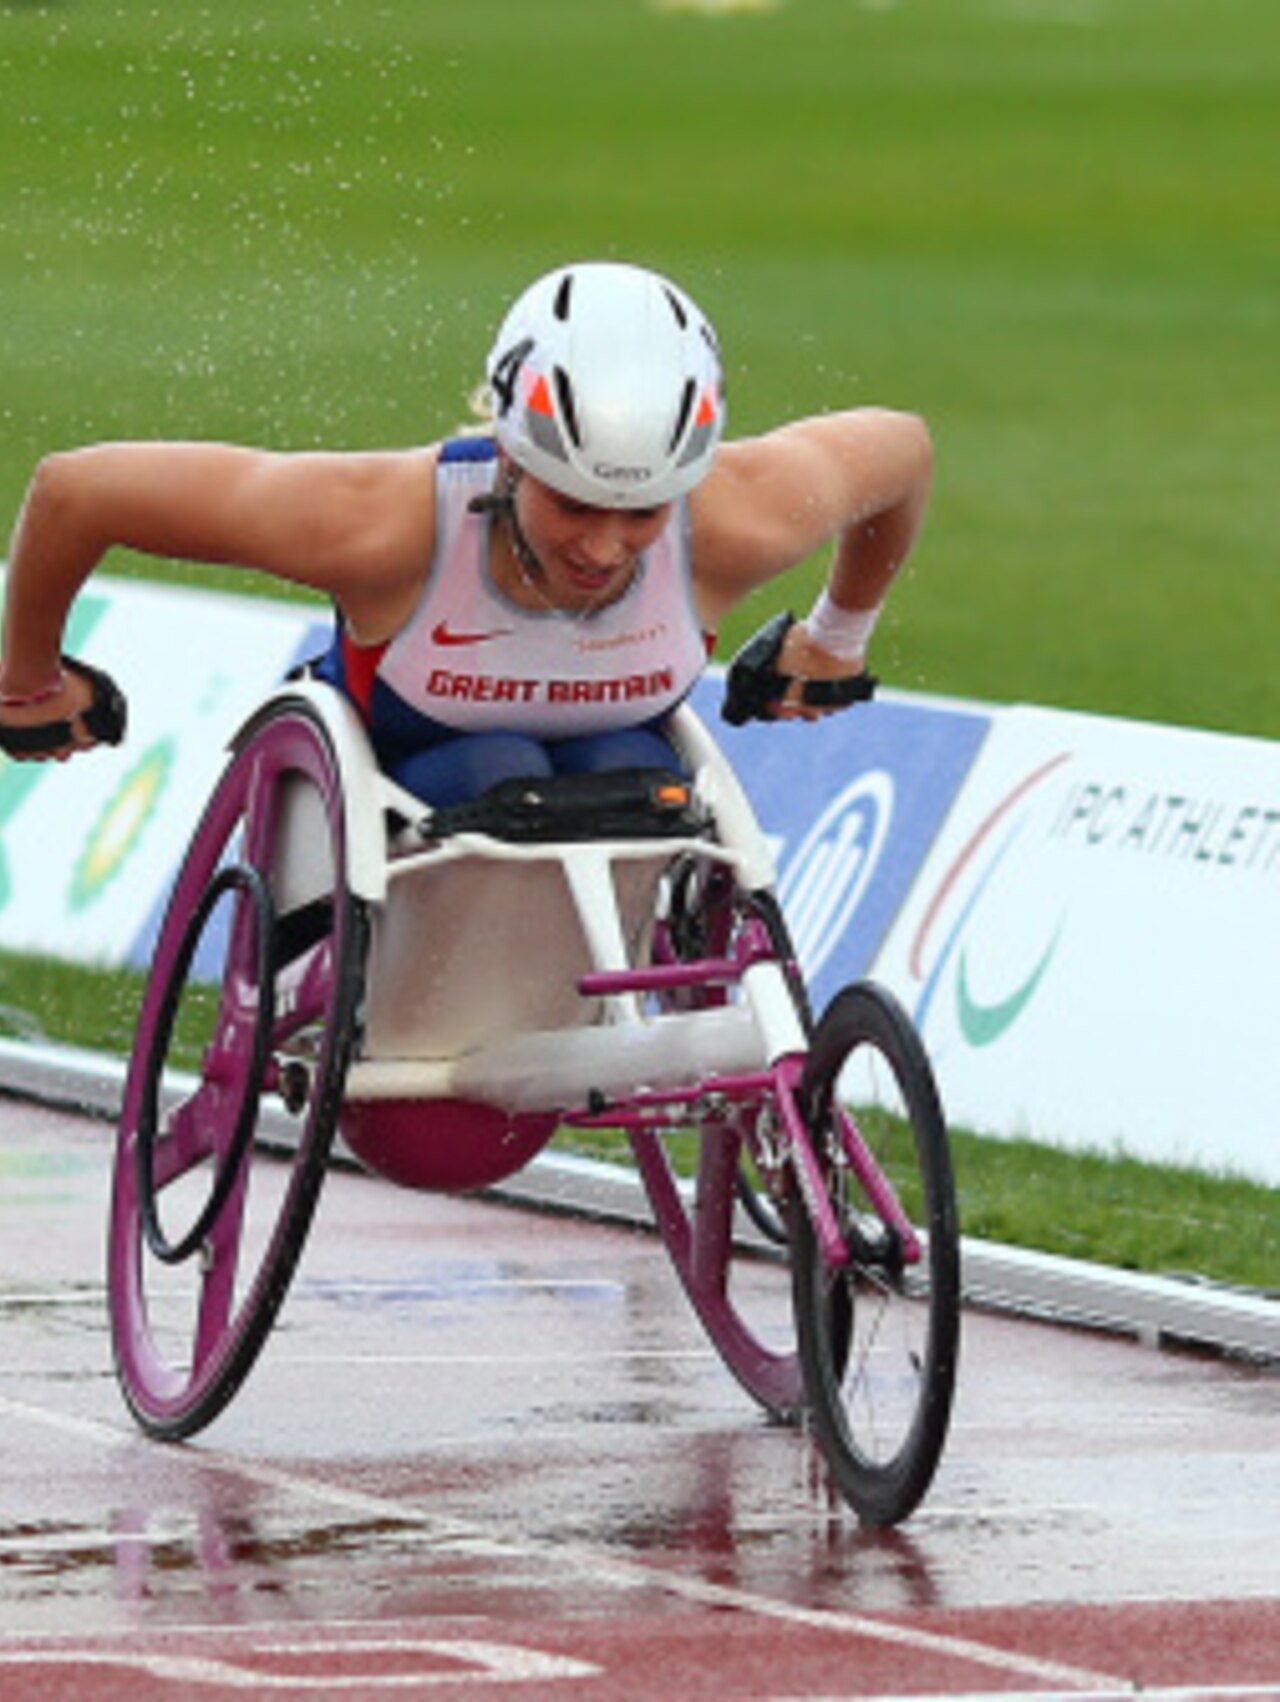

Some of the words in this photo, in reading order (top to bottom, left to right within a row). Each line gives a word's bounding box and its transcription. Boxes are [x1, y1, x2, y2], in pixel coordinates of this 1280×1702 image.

[426, 670, 540, 702] GREAT
[546, 667, 675, 703] BRITAIN
[1046, 783, 1126, 846] IPC
